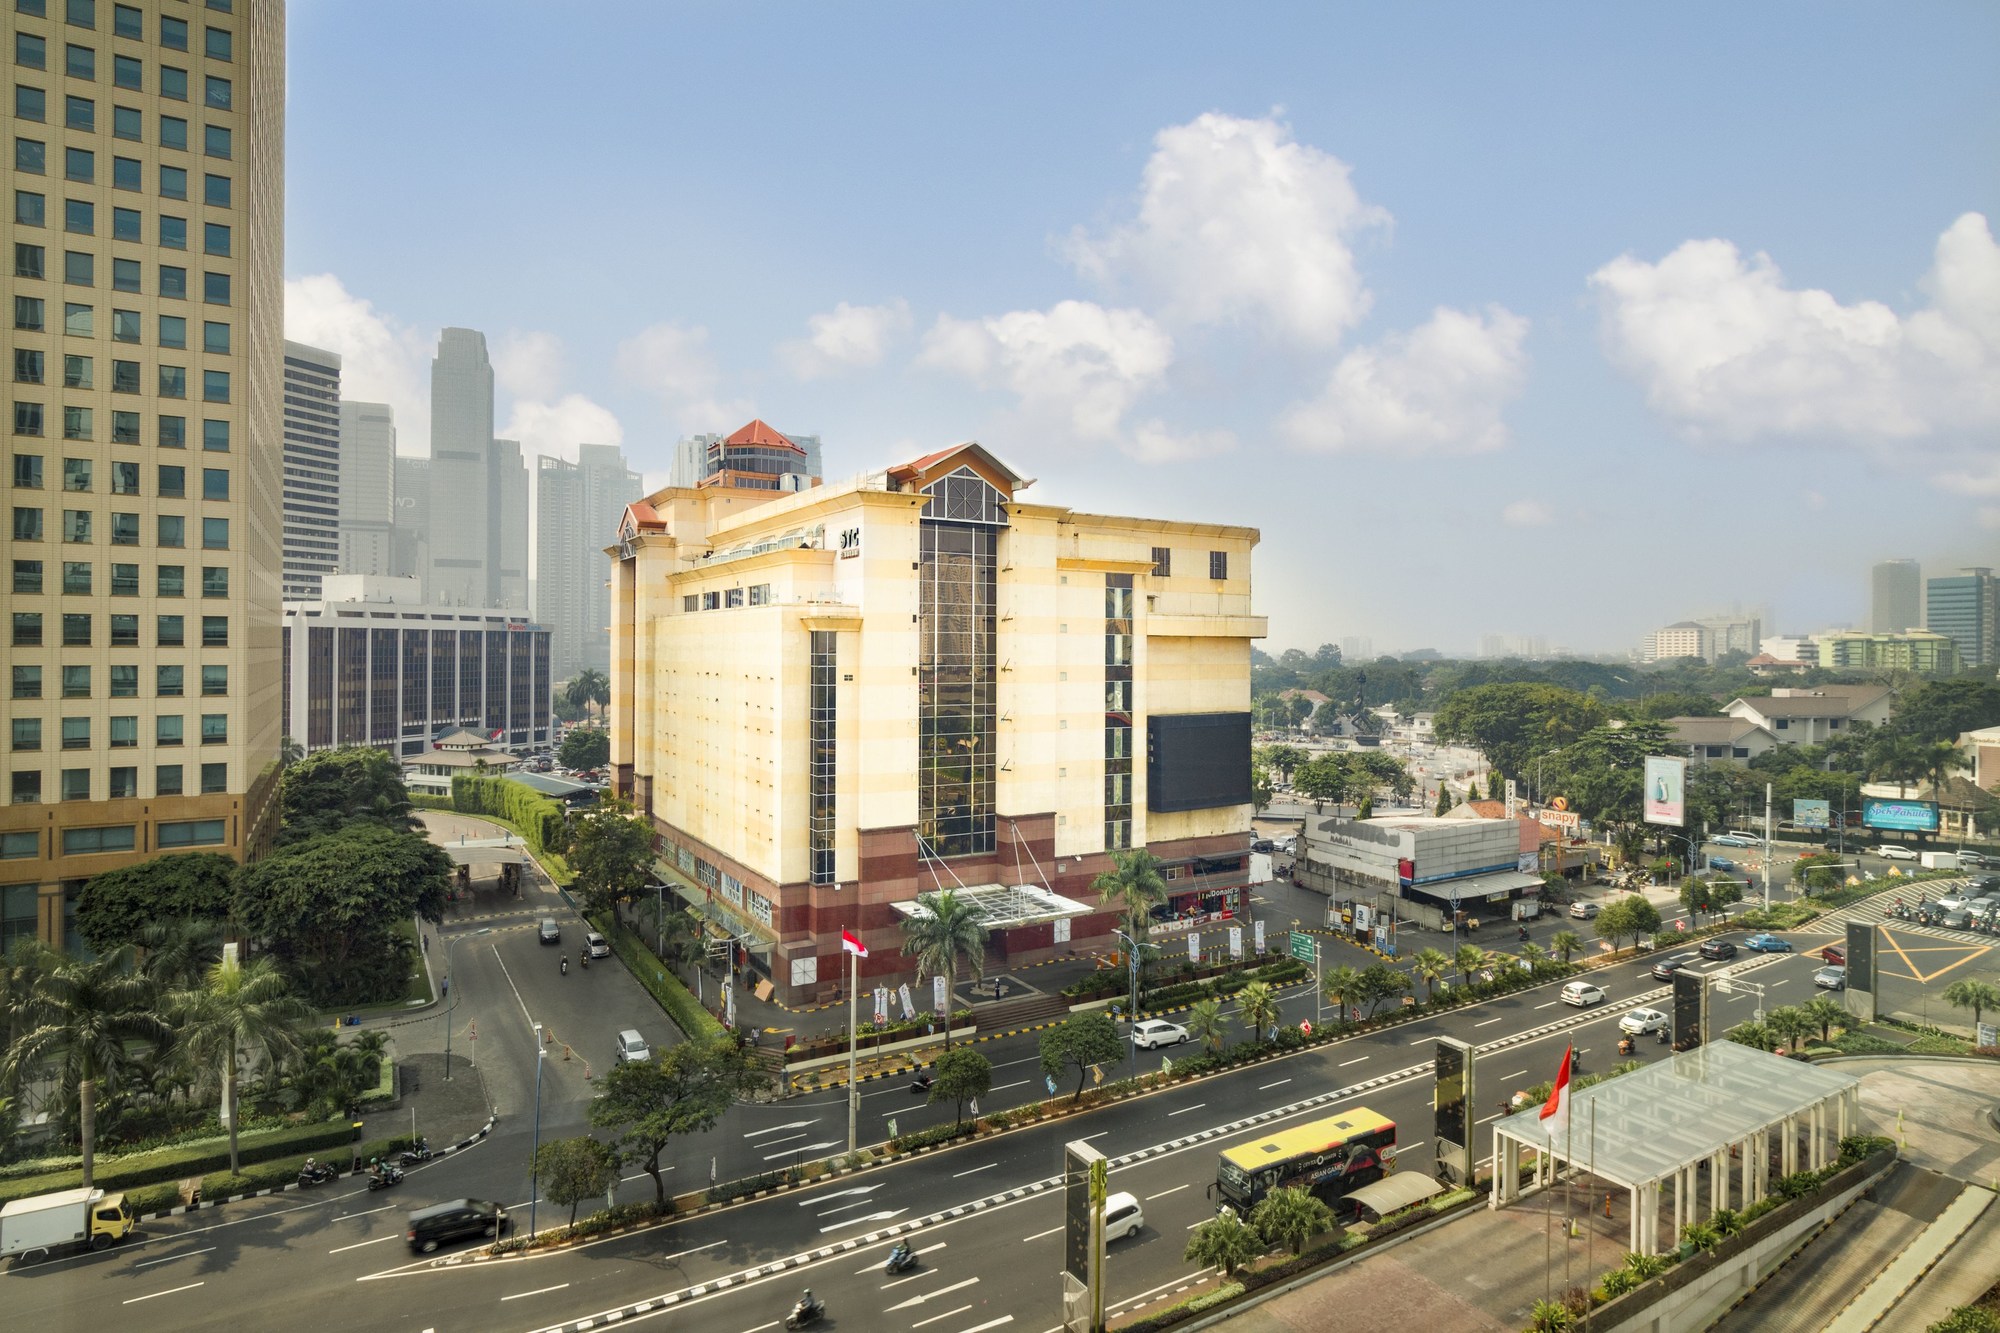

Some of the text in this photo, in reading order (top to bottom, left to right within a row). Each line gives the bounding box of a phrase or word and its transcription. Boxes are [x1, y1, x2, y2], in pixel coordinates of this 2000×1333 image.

[507, 623, 543, 631] PaninBank
[1542, 811, 1576, 825] snapy
[1311, 1168, 1327, 1180] ASIAN
[1327, 1163, 1345, 1175] GAMES
